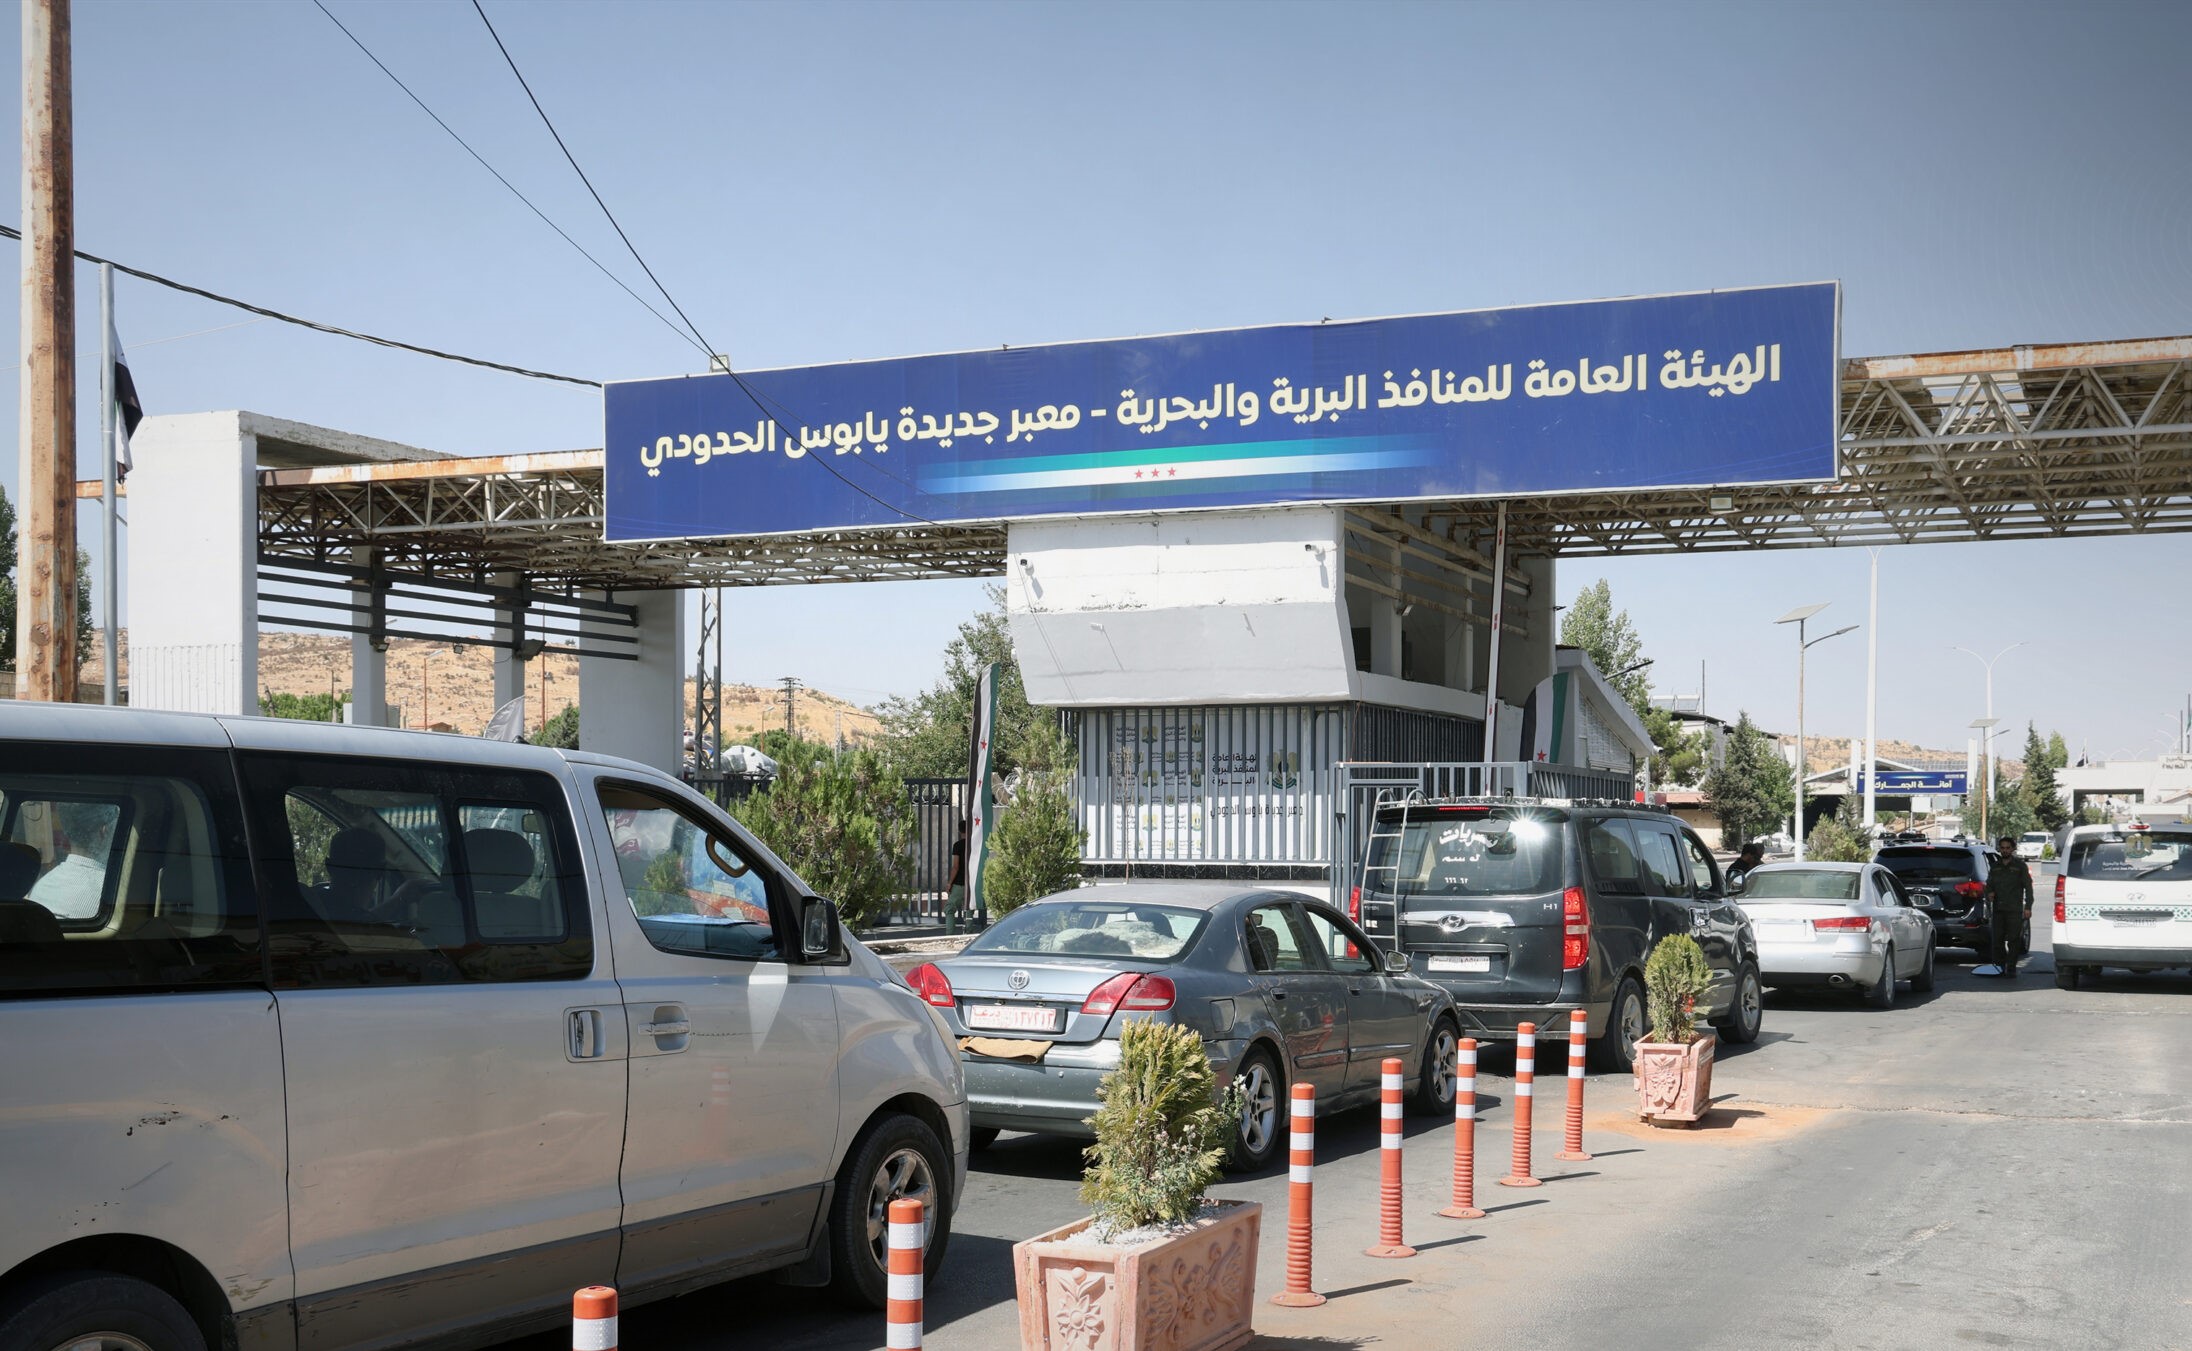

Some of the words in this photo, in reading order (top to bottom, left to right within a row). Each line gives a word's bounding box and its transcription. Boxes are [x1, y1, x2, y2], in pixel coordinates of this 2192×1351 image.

[1378, 364, 1512, 409] للمنافذ
[1525, 354, 1647, 398] العامة
[1660, 344, 1780, 397] الهيئة
[1091, 407, 1107, 417] -
[1117, 383, 1259, 434] والبحرية
[1270, 375, 1367, 424] البرية
[783, 411, 889, 459] يابوس
[897, 405, 1000, 448] جديدة
[1007, 405, 1081, 443] معبر
[640, 420, 776, 477] الحدودي
